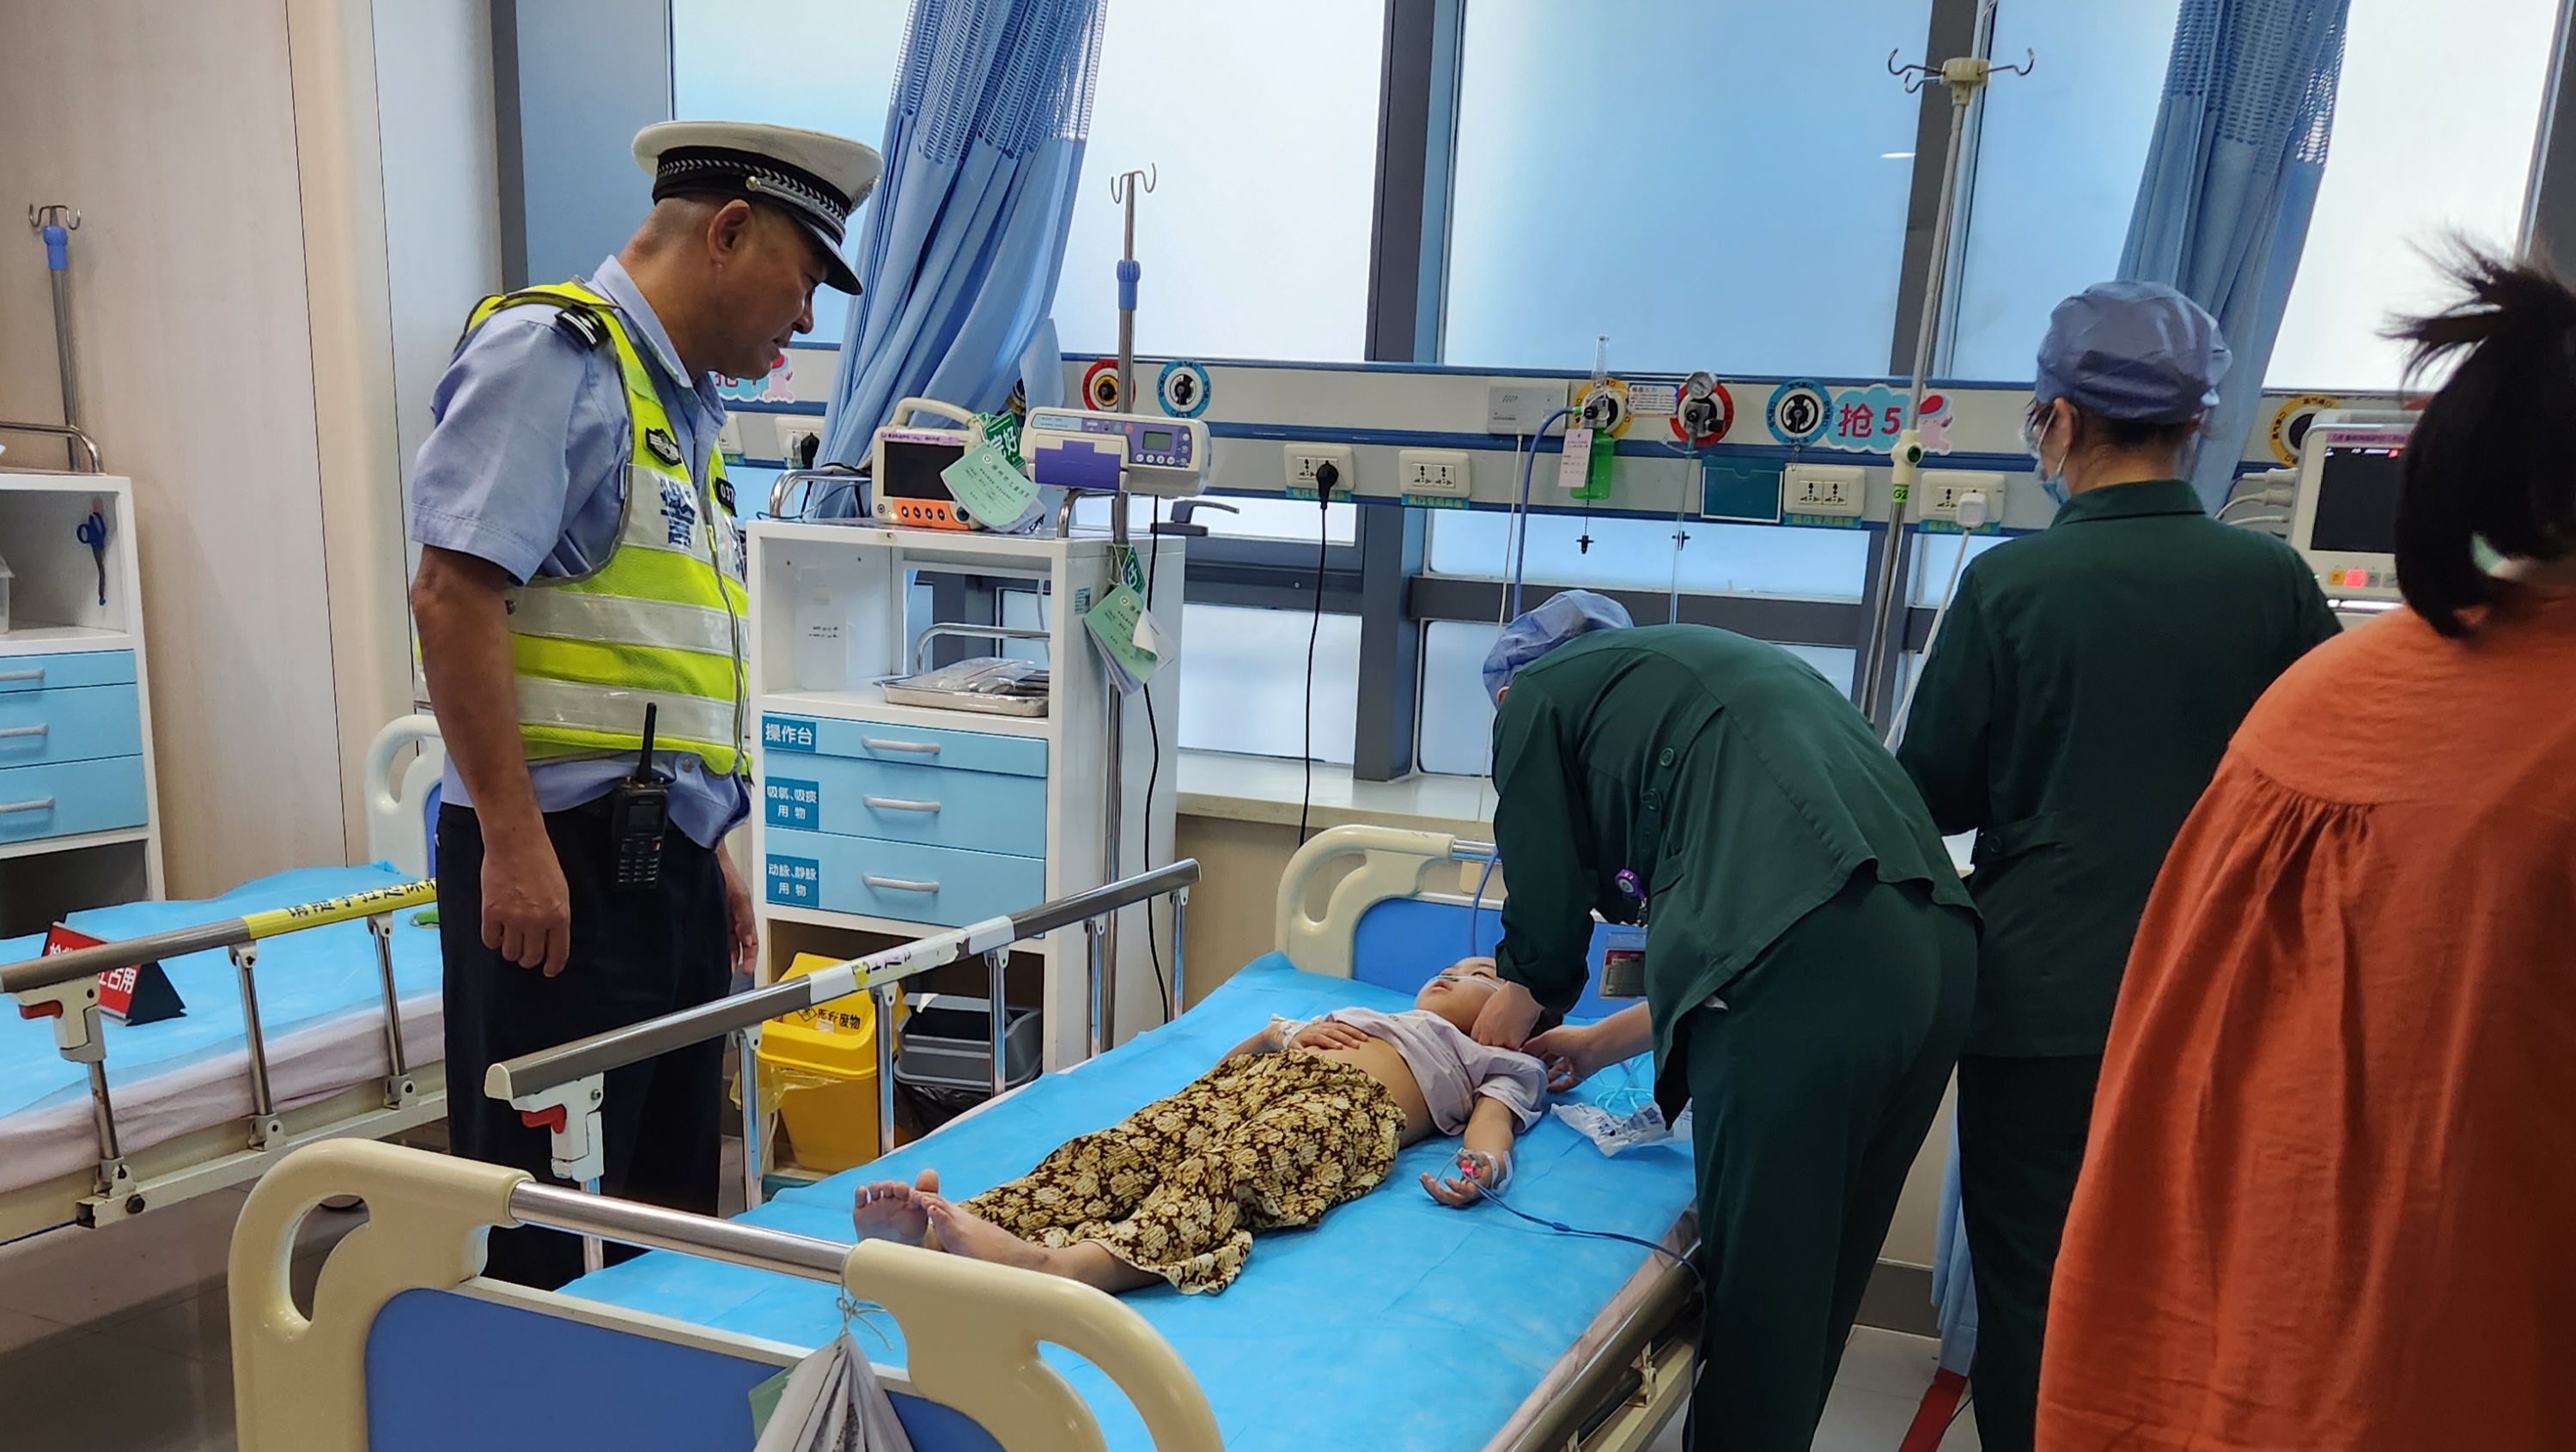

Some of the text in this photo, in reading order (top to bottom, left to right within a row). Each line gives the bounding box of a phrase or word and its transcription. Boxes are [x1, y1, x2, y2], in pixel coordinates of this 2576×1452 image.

[720, 483, 735, 503] 037
[1892, 487, 1909, 500] G2
[764, 722, 813, 745] 操作台
[766, 785, 818, 804] 吸氧、吸痰
[768, 863, 818, 881] 动脉、静脉
